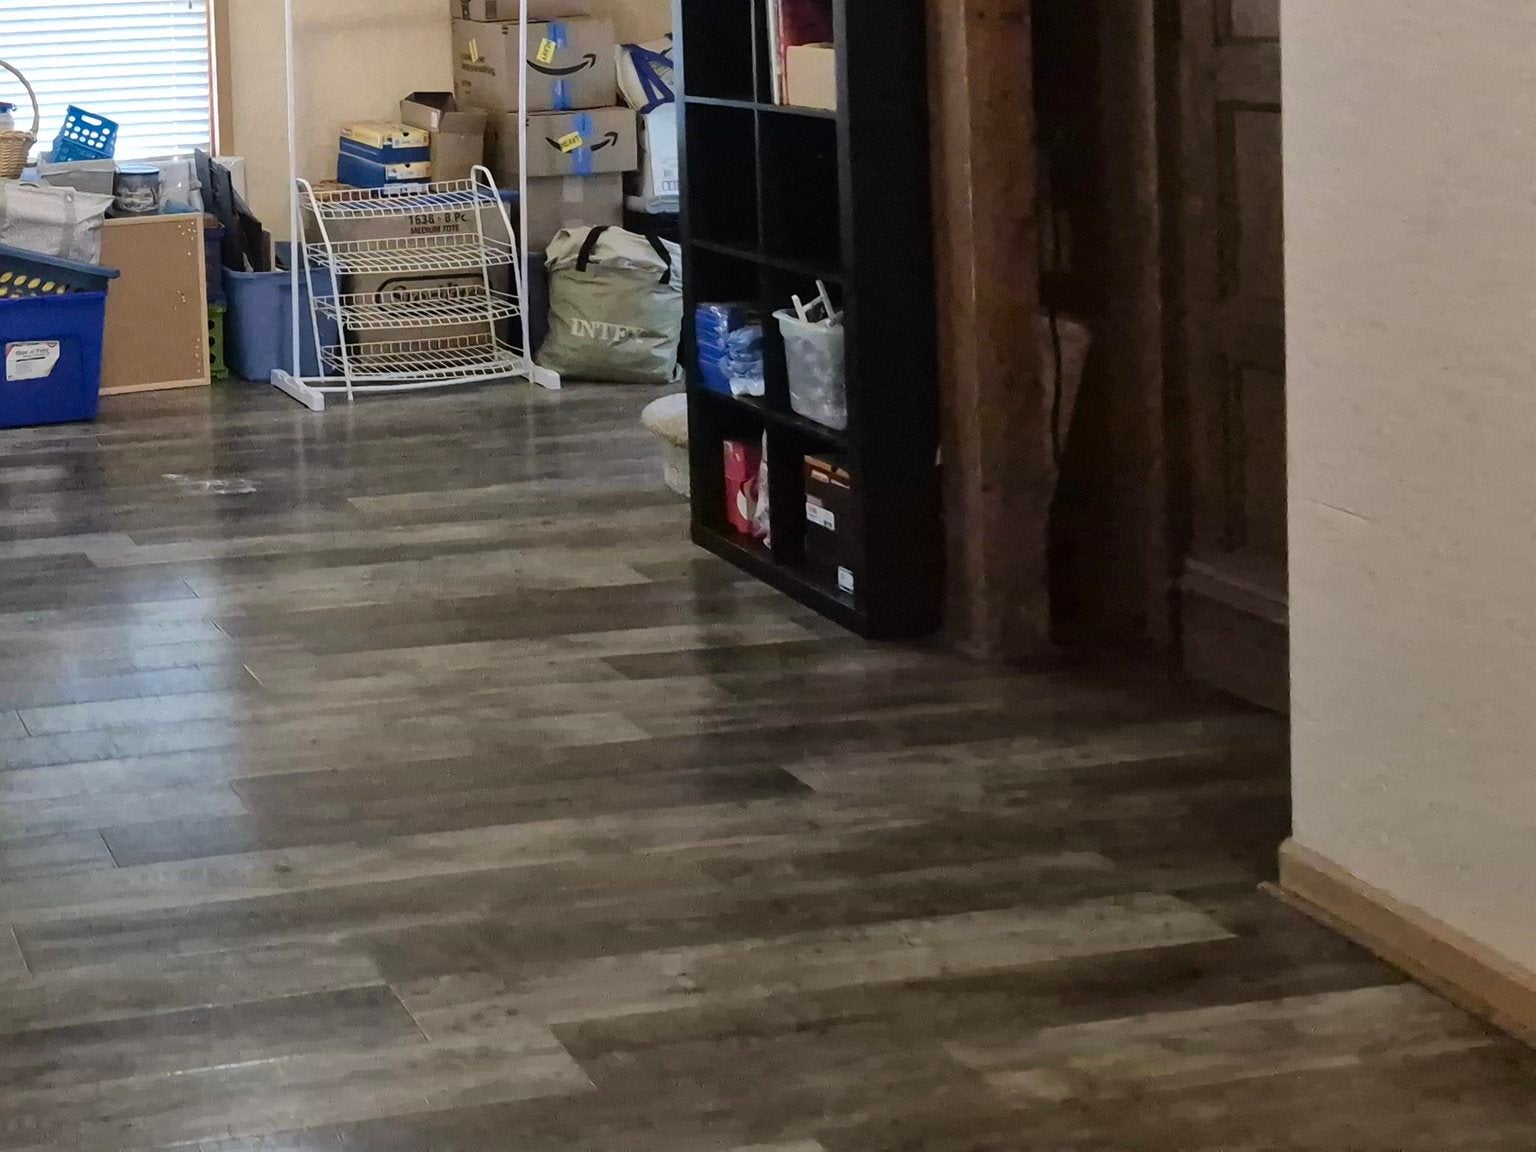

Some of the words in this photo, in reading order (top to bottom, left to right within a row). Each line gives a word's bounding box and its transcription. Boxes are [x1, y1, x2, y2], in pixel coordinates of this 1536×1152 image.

[408, 213, 435, 226] 1638
[410, 225, 441, 235] MEDIUM
[442, 223, 460, 234] TOTE
